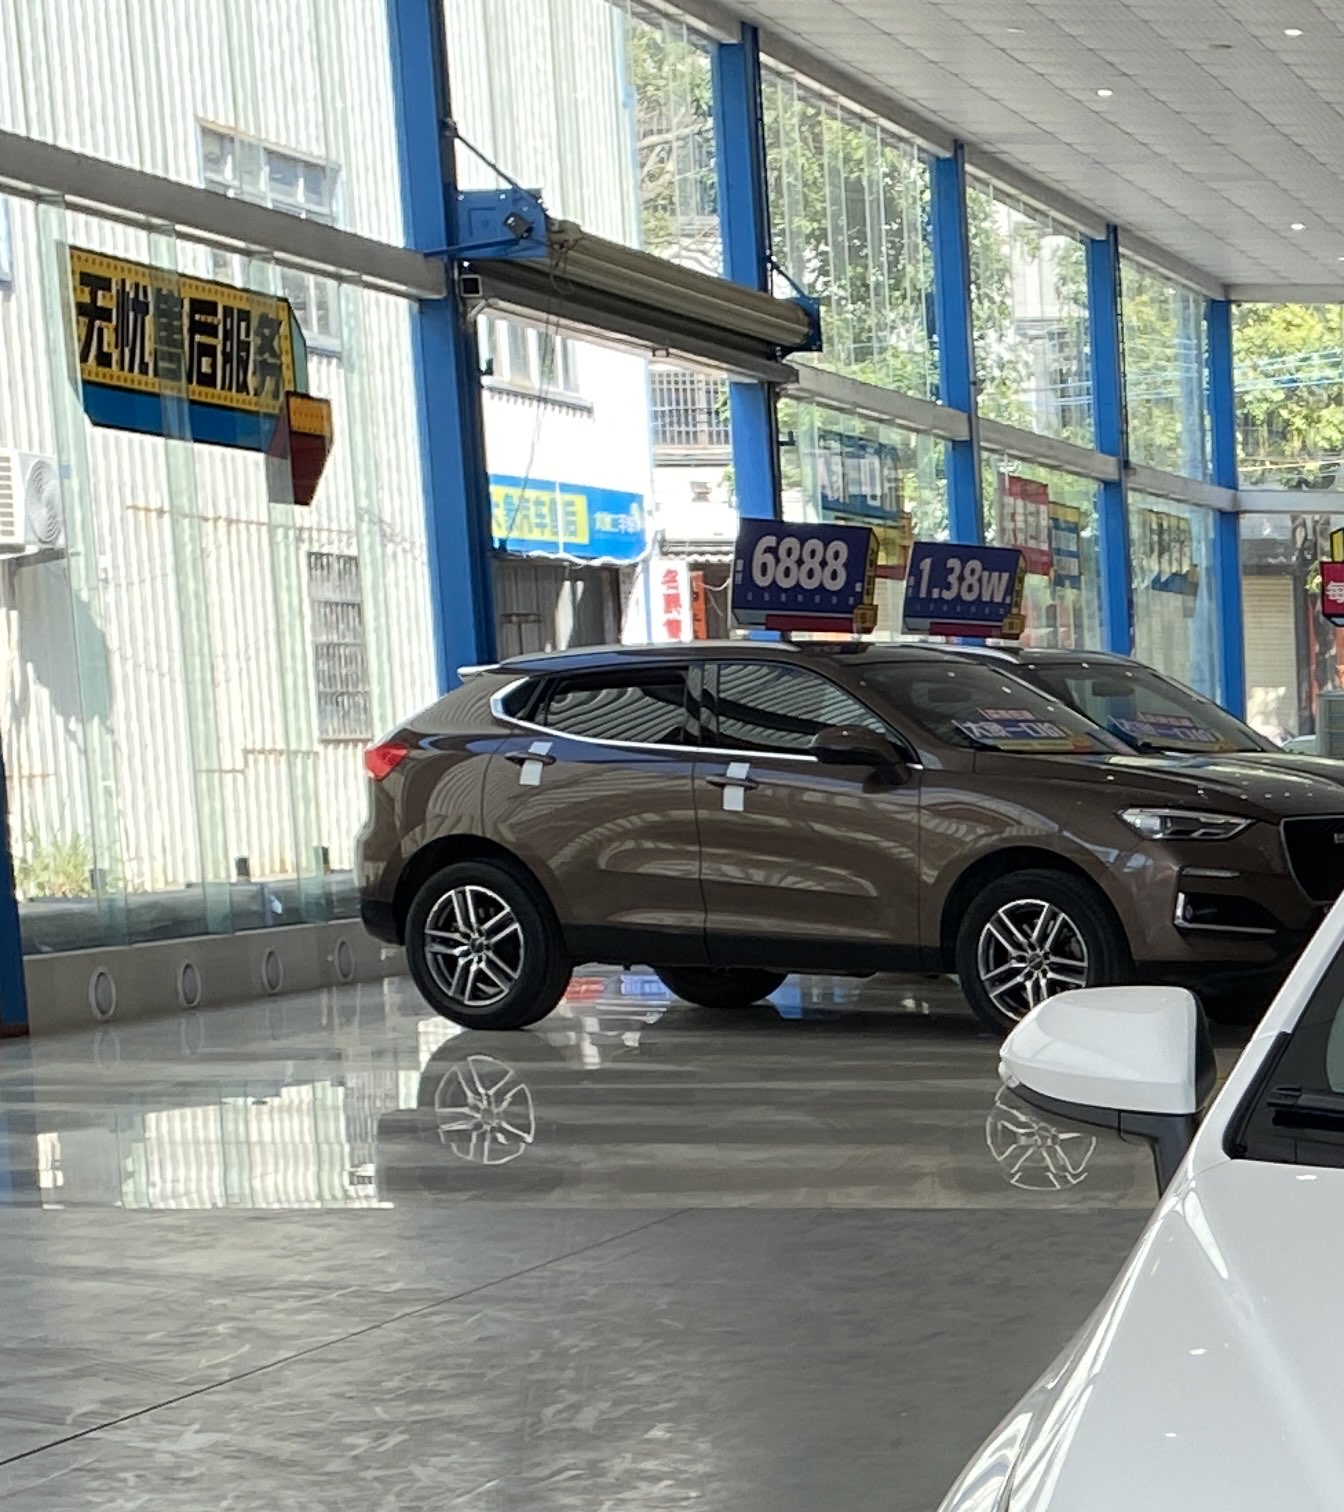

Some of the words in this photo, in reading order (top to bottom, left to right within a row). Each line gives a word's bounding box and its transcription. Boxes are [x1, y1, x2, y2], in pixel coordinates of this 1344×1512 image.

[78, 271, 282, 397] 无忧售后服务
[752, 535, 849, 591] 6888
